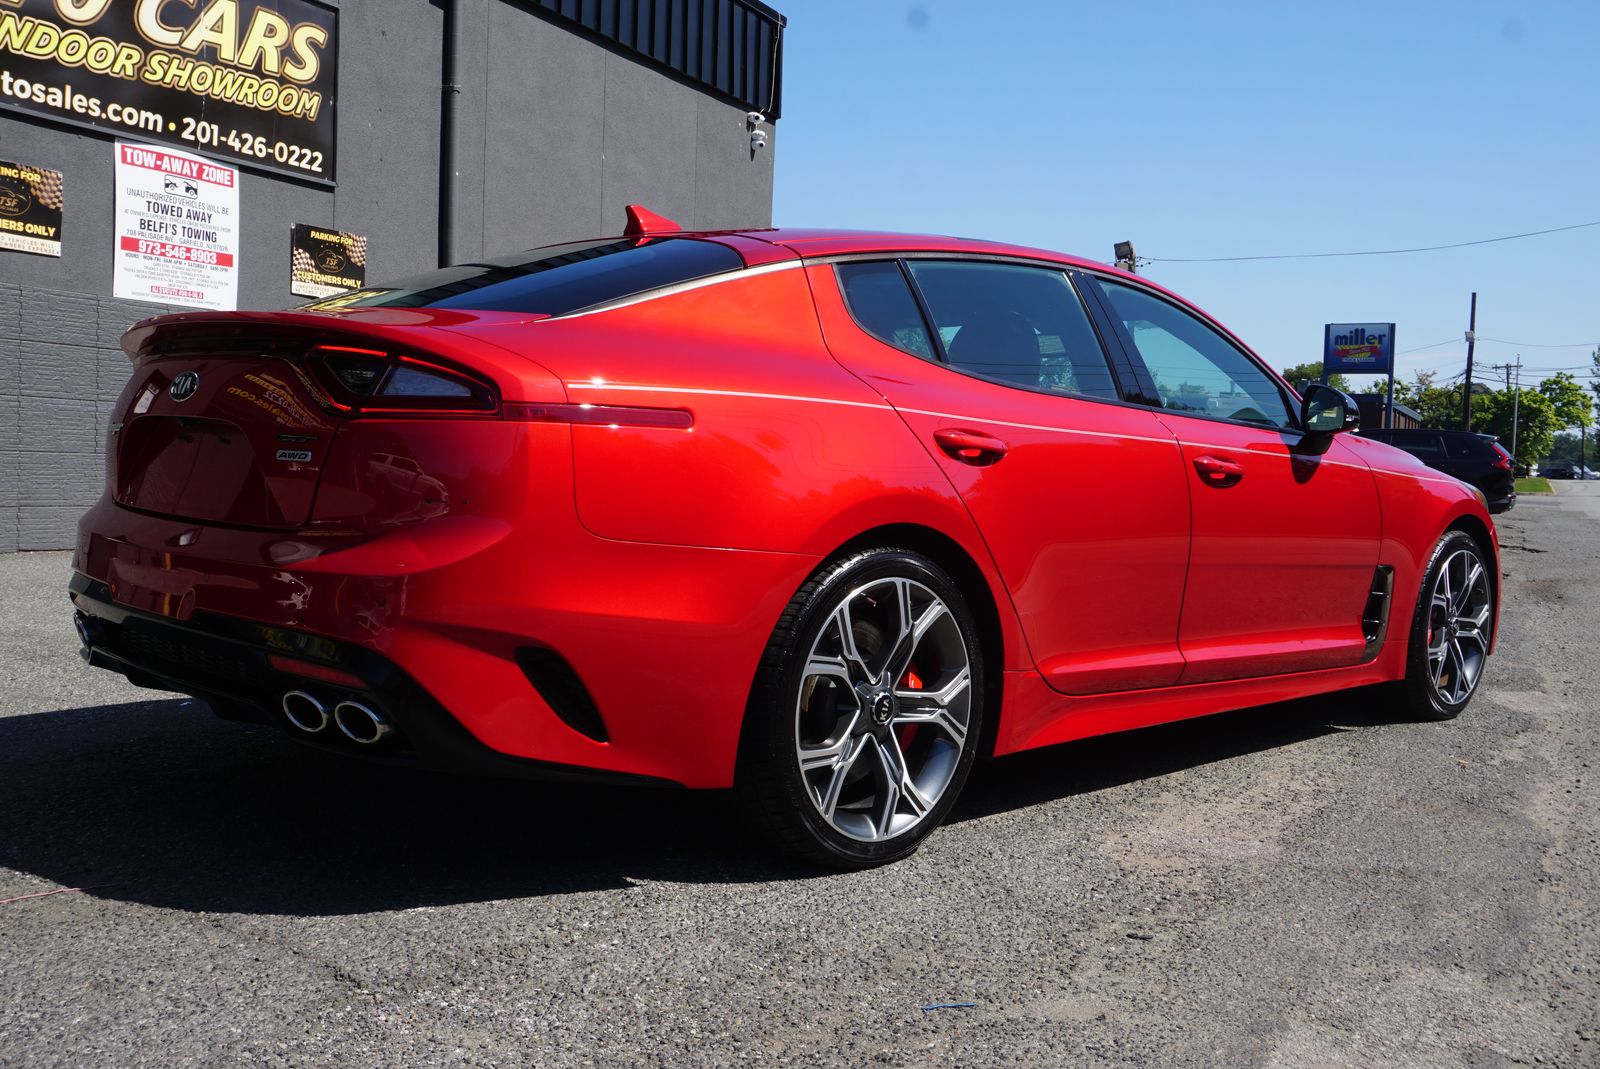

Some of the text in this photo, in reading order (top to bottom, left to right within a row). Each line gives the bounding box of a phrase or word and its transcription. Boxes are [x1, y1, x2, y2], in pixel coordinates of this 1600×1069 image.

[134, 0, 329, 84] CARS
[0, 9, 322, 121] NDOOR SHOWROOM
[0, 71, 323, 172] tosales.com 201-426-0222
[20, 171, 41, 183] FOR
[124, 147, 231, 186] TOW-AWAY ZONE
[126, 187, 229, 216] UNAUTHORIZED VEHICLES WILL BE
[146, 200, 213, 224] TOWED AWAY
[25, 223, 56, 237] ONLY
[138, 230, 164, 241] PALISADE
[139, 218, 217, 243] BELFI'S TOWING
[310, 230, 354, 246] PARKING FOR
[138, 240, 217, 264] 973-546-8903
[325, 257, 338, 266] TSF
[296, 271, 362, 289] CUSTOMERS ONLY
[1334, 327, 1387, 346] miller
[170, 376, 192, 394] KIA
[278, 452, 309, 460] AWD
[880, 698, 890, 721] KIA
